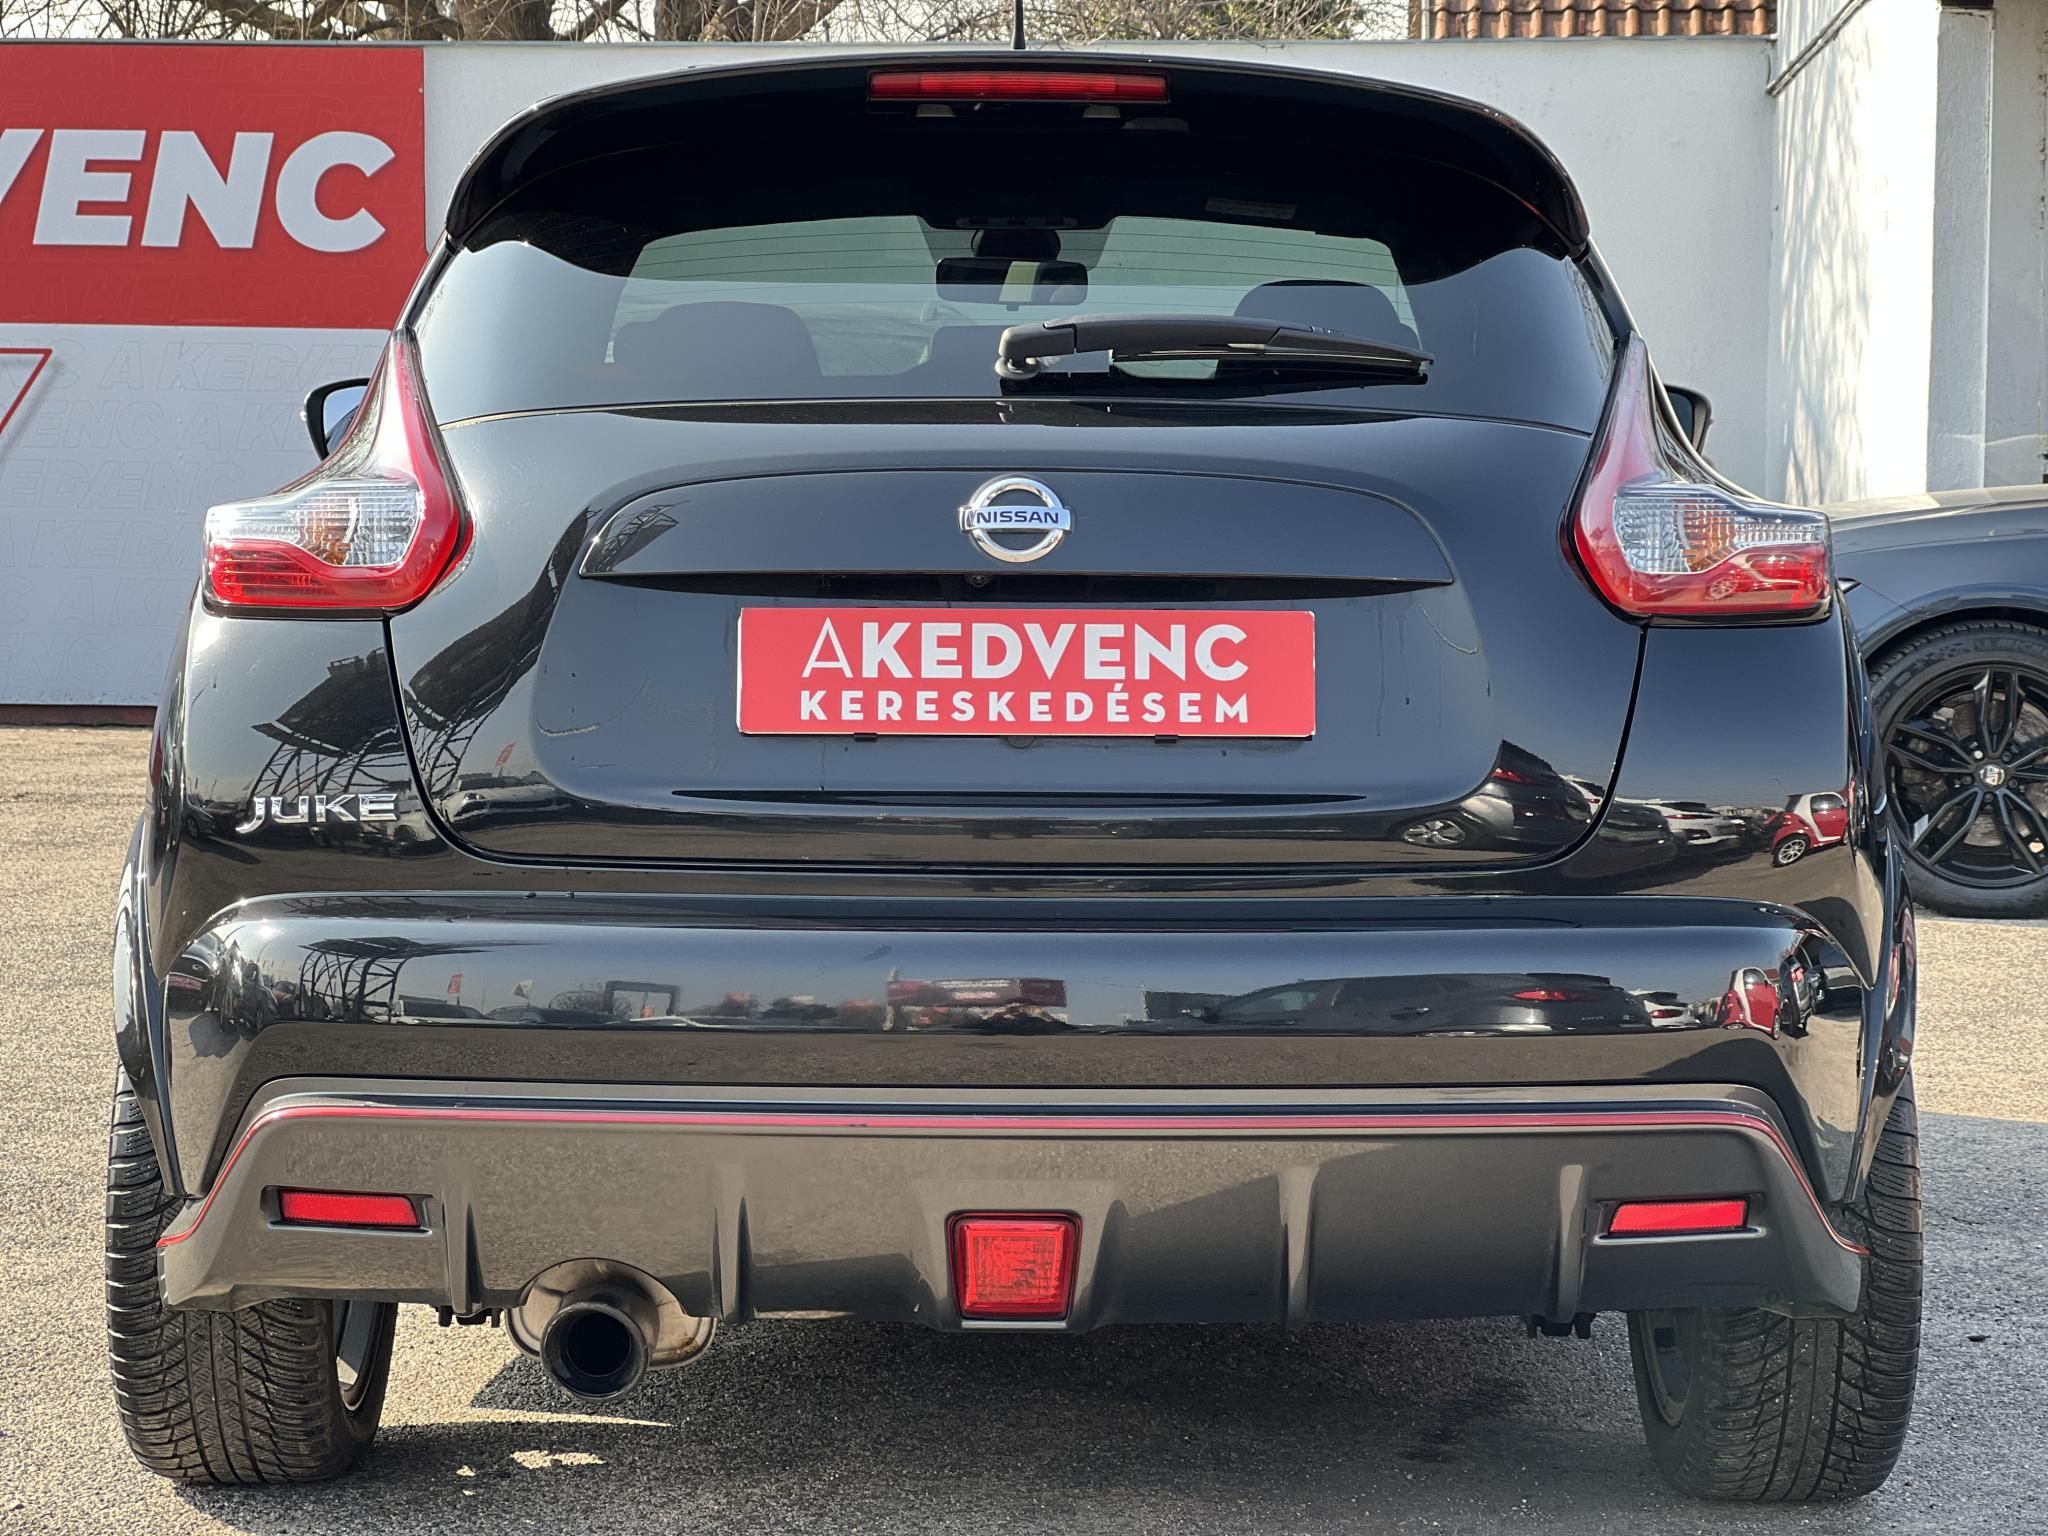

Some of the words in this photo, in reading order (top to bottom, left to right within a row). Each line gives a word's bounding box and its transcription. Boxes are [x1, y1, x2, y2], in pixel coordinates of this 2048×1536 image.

[976, 510, 1059, 524] NISSAN
[800, 683, 1249, 723] KERESKEDÉSEM
[235, 793, 398, 834] JUKE
